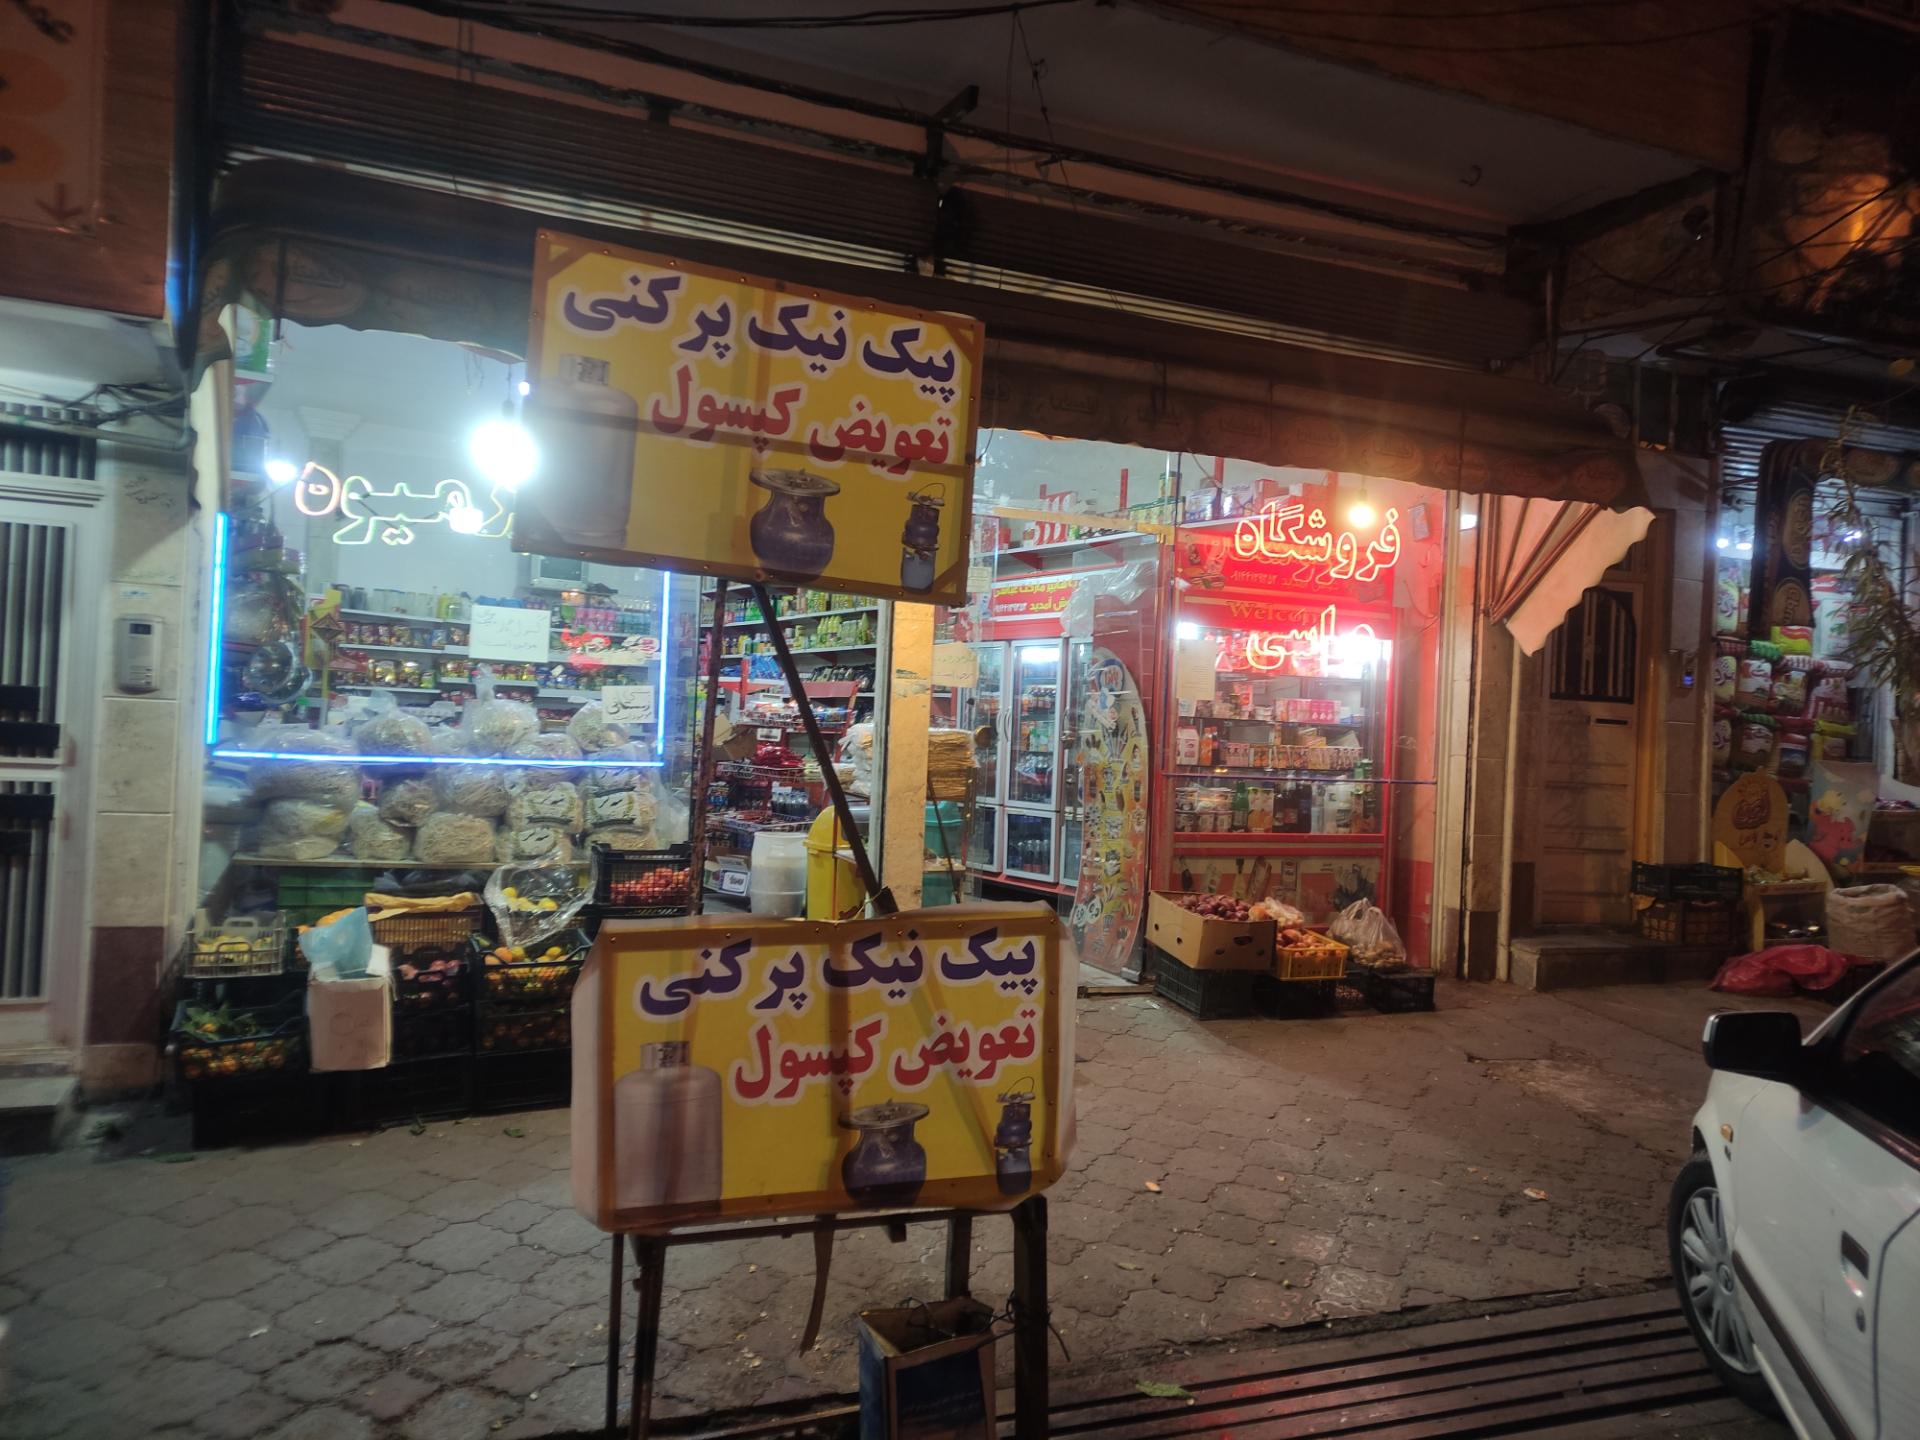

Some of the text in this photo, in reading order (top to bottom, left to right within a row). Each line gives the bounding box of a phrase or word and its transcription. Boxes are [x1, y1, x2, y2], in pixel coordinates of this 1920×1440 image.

[563, 274, 957, 403] پیک نیک پر کنی
[651, 364, 952, 475] تعویض کپسول
[1234, 499, 1401, 583] فروشگاه
[640, 927, 1038, 1015] پیک نیک پر کنی
[735, 1009, 1037, 1100] تعویض کپسول
